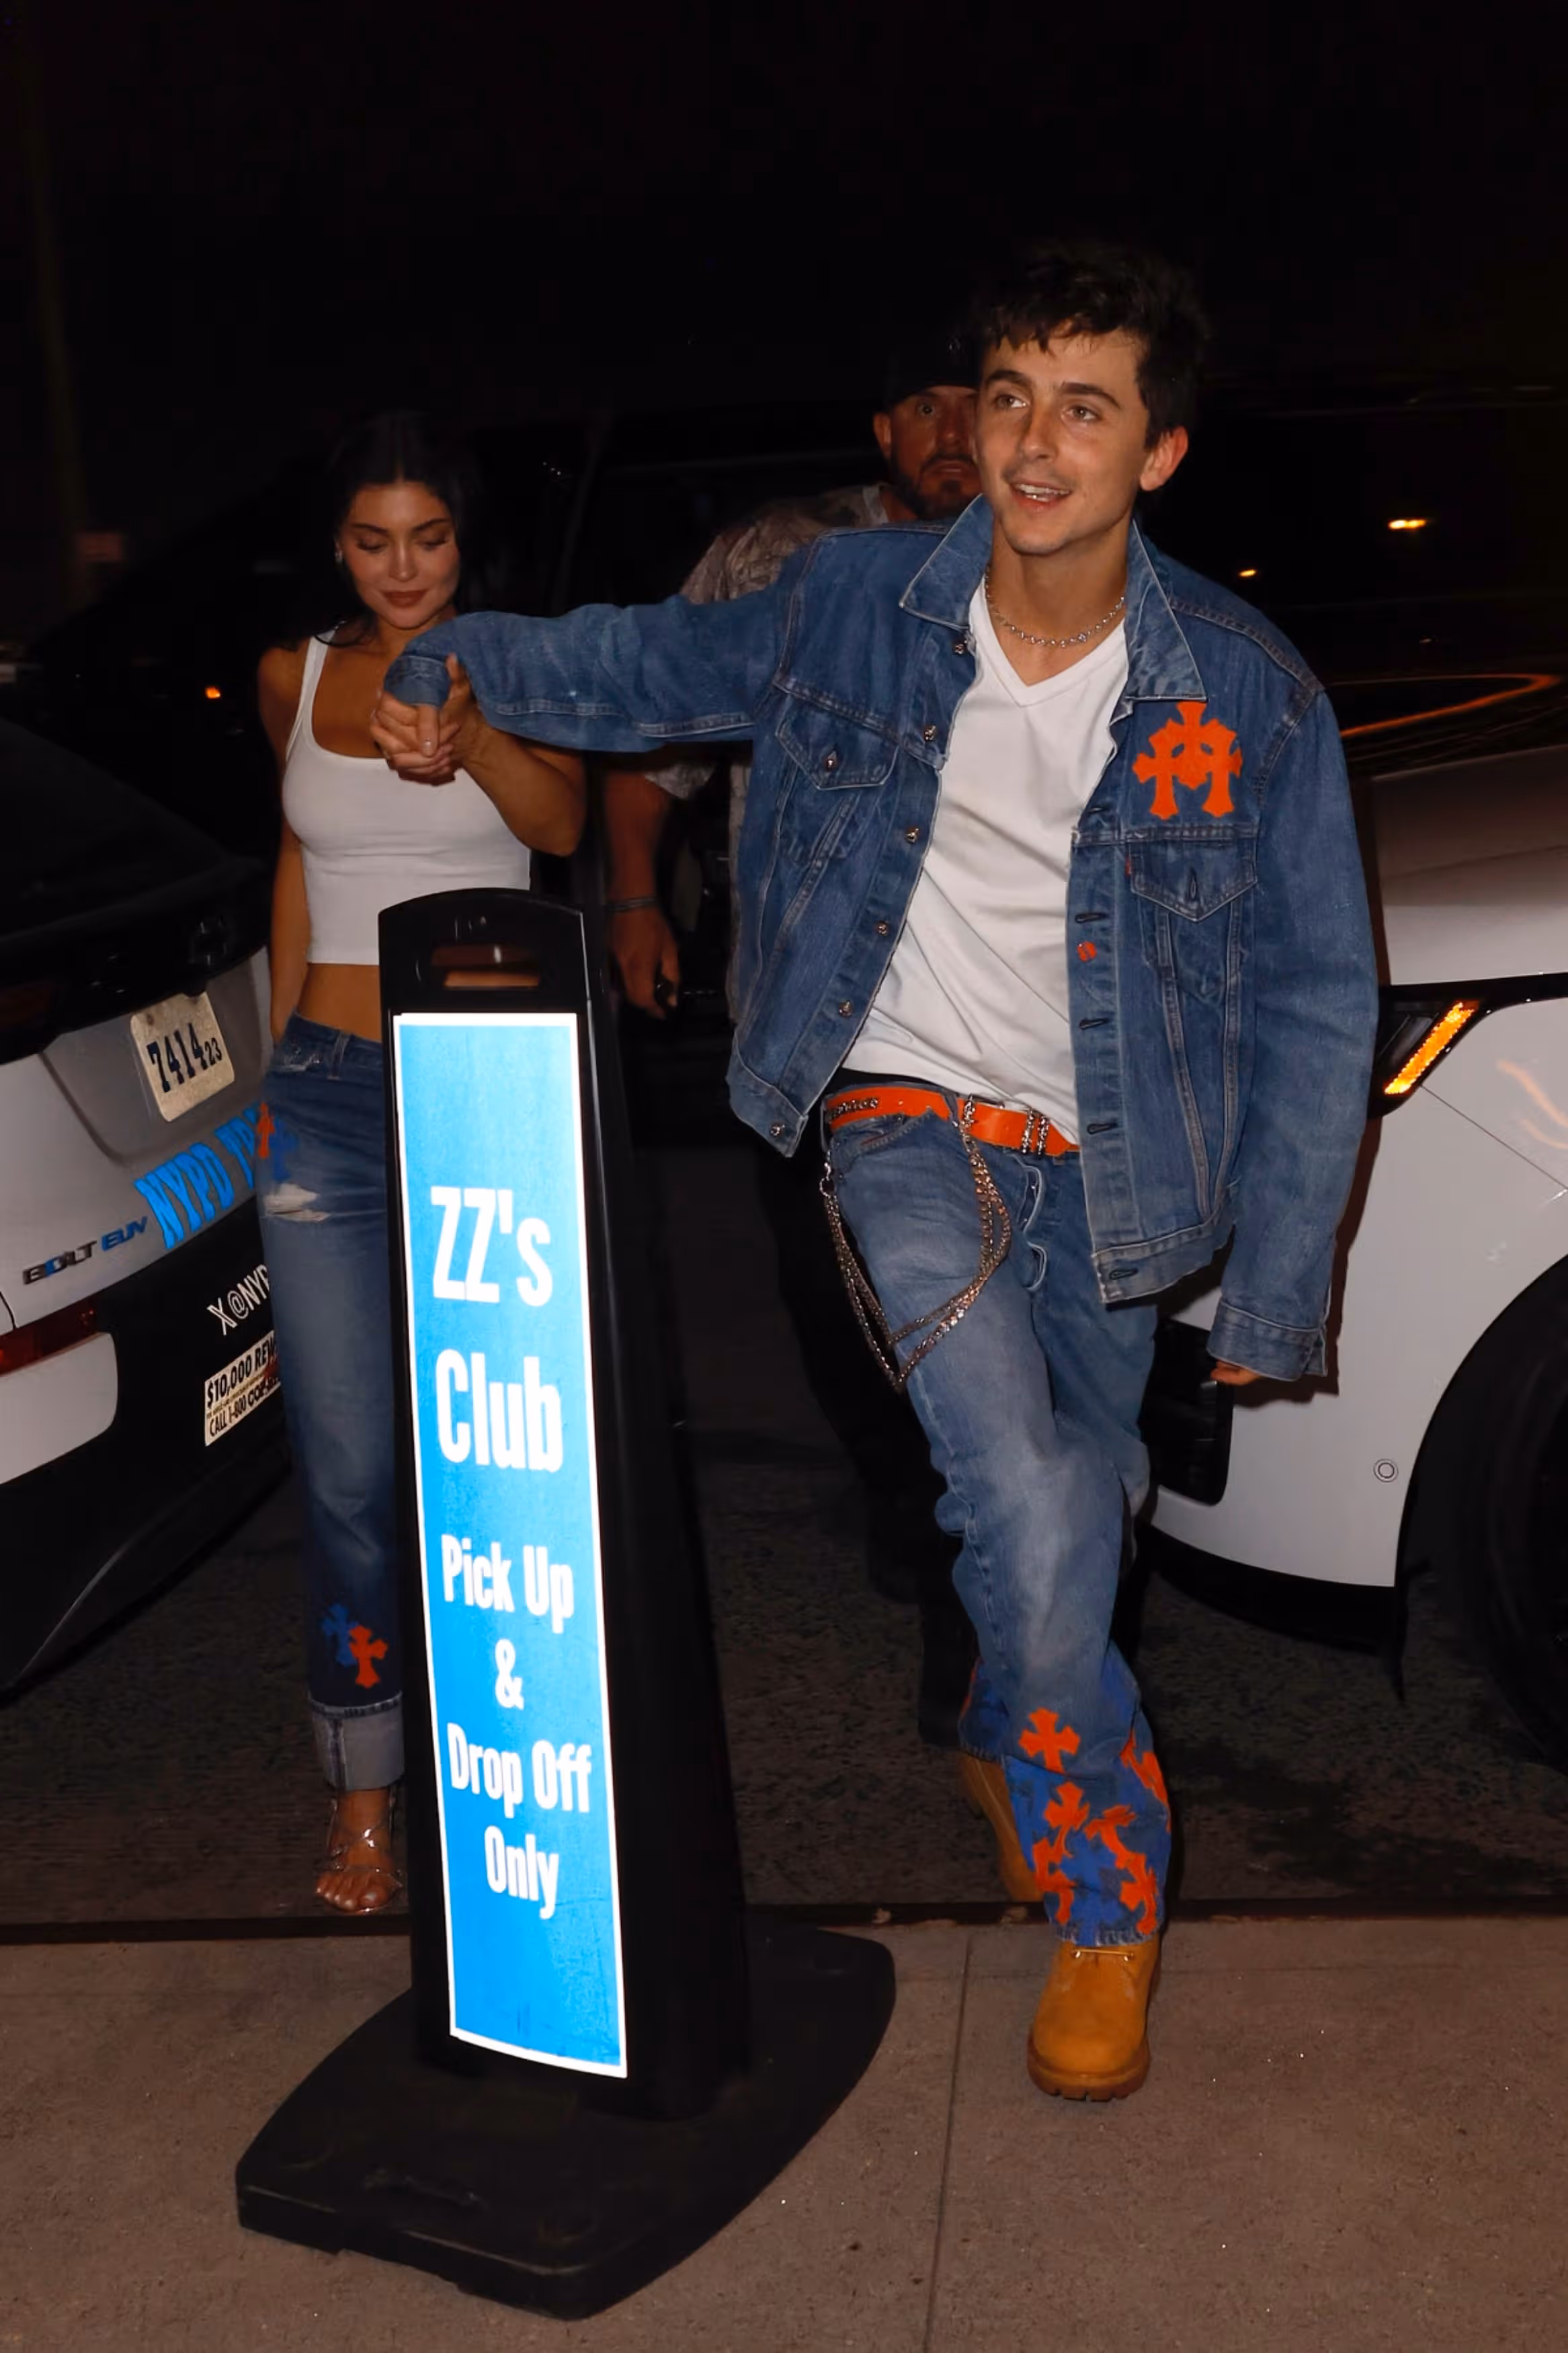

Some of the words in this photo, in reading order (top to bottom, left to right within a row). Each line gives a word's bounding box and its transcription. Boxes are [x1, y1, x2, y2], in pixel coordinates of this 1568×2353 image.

[146, 1021, 208, 1093] 7414
[204, 1036, 223, 1066] 23
[134, 1141, 235, 1249] NYPD
[22, 1240, 97, 1286] BOLT
[101, 1215, 148, 1252] EUV
[430, 1185, 554, 1308] ZZ's
[207, 1354, 251, 1410] $10,000
[209, 1408, 226, 1437] CALL
[435, 1349, 565, 1473] Club
[441, 1533, 515, 1613] Pick
[523, 1545, 575, 1635] Up
[494, 1638, 525, 1710] &
[446, 1722, 524, 1819] Drop
[531, 1740, 593, 1814] Off
[483, 1825, 560, 1921] Only
